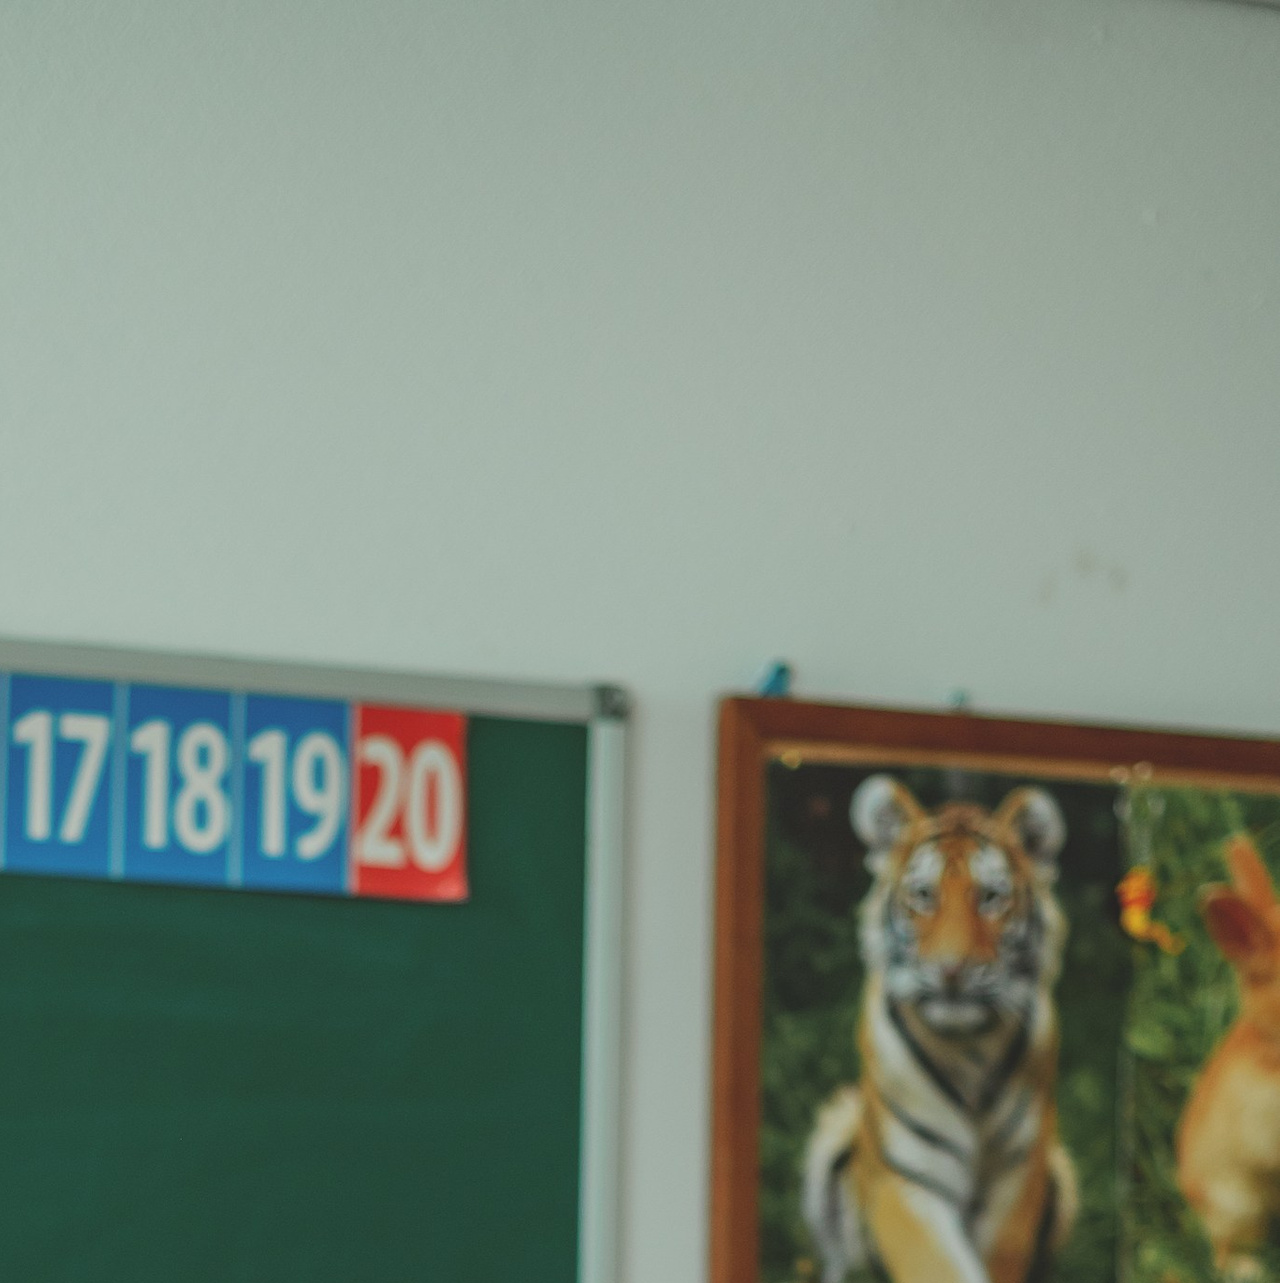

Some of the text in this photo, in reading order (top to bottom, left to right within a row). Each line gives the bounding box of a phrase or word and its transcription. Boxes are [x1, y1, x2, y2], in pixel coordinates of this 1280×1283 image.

[11, 710, 112, 844] 17
[129, 721, 232, 854] 18
[246, 729, 347, 861] 19
[356, 736, 465, 873] 20
